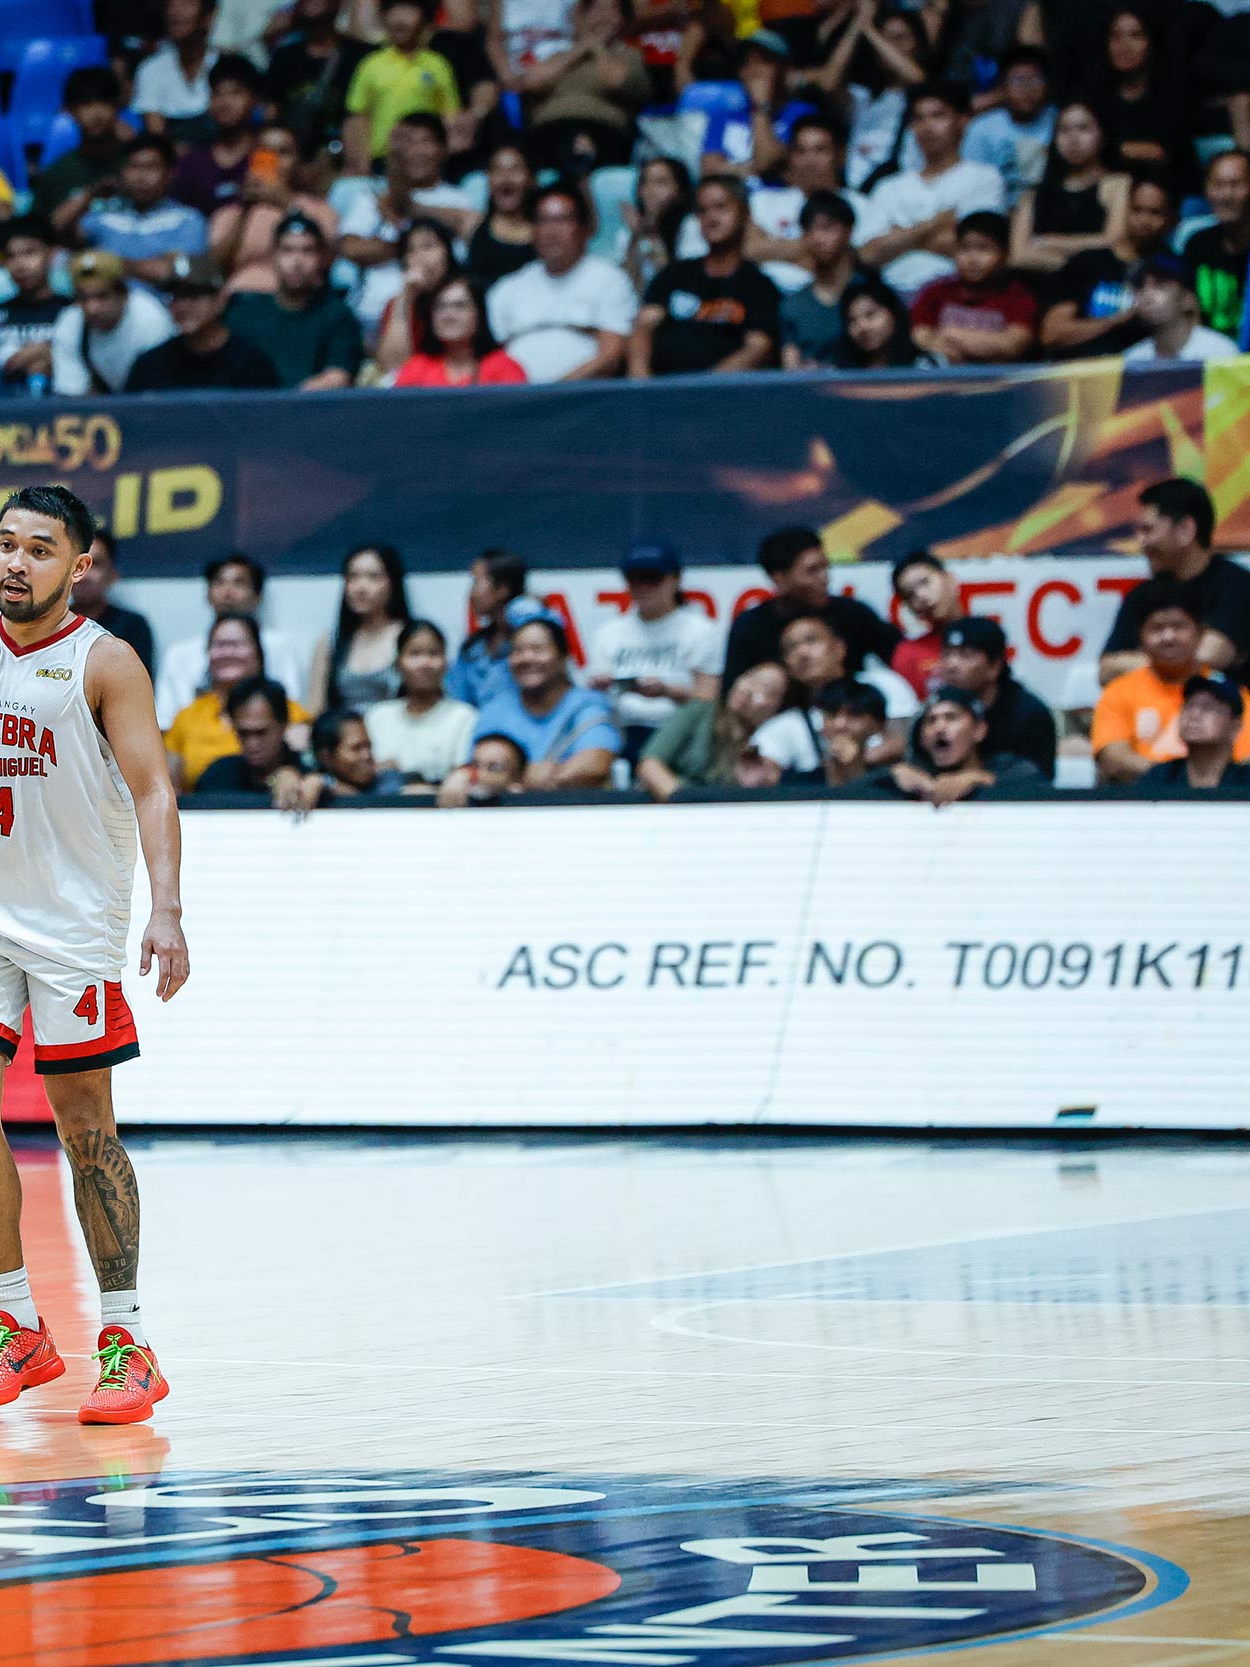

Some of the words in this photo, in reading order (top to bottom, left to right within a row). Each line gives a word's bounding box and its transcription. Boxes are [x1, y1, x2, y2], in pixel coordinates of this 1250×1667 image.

[498, 942, 629, 990] ASC
[647, 941, 779, 988] REF.
[804, 941, 917, 988] NO.
[945, 941, 1244, 990] T0091K11
[72, 984, 99, 1026] 4
[200, 1530, 1037, 1667] NTER
